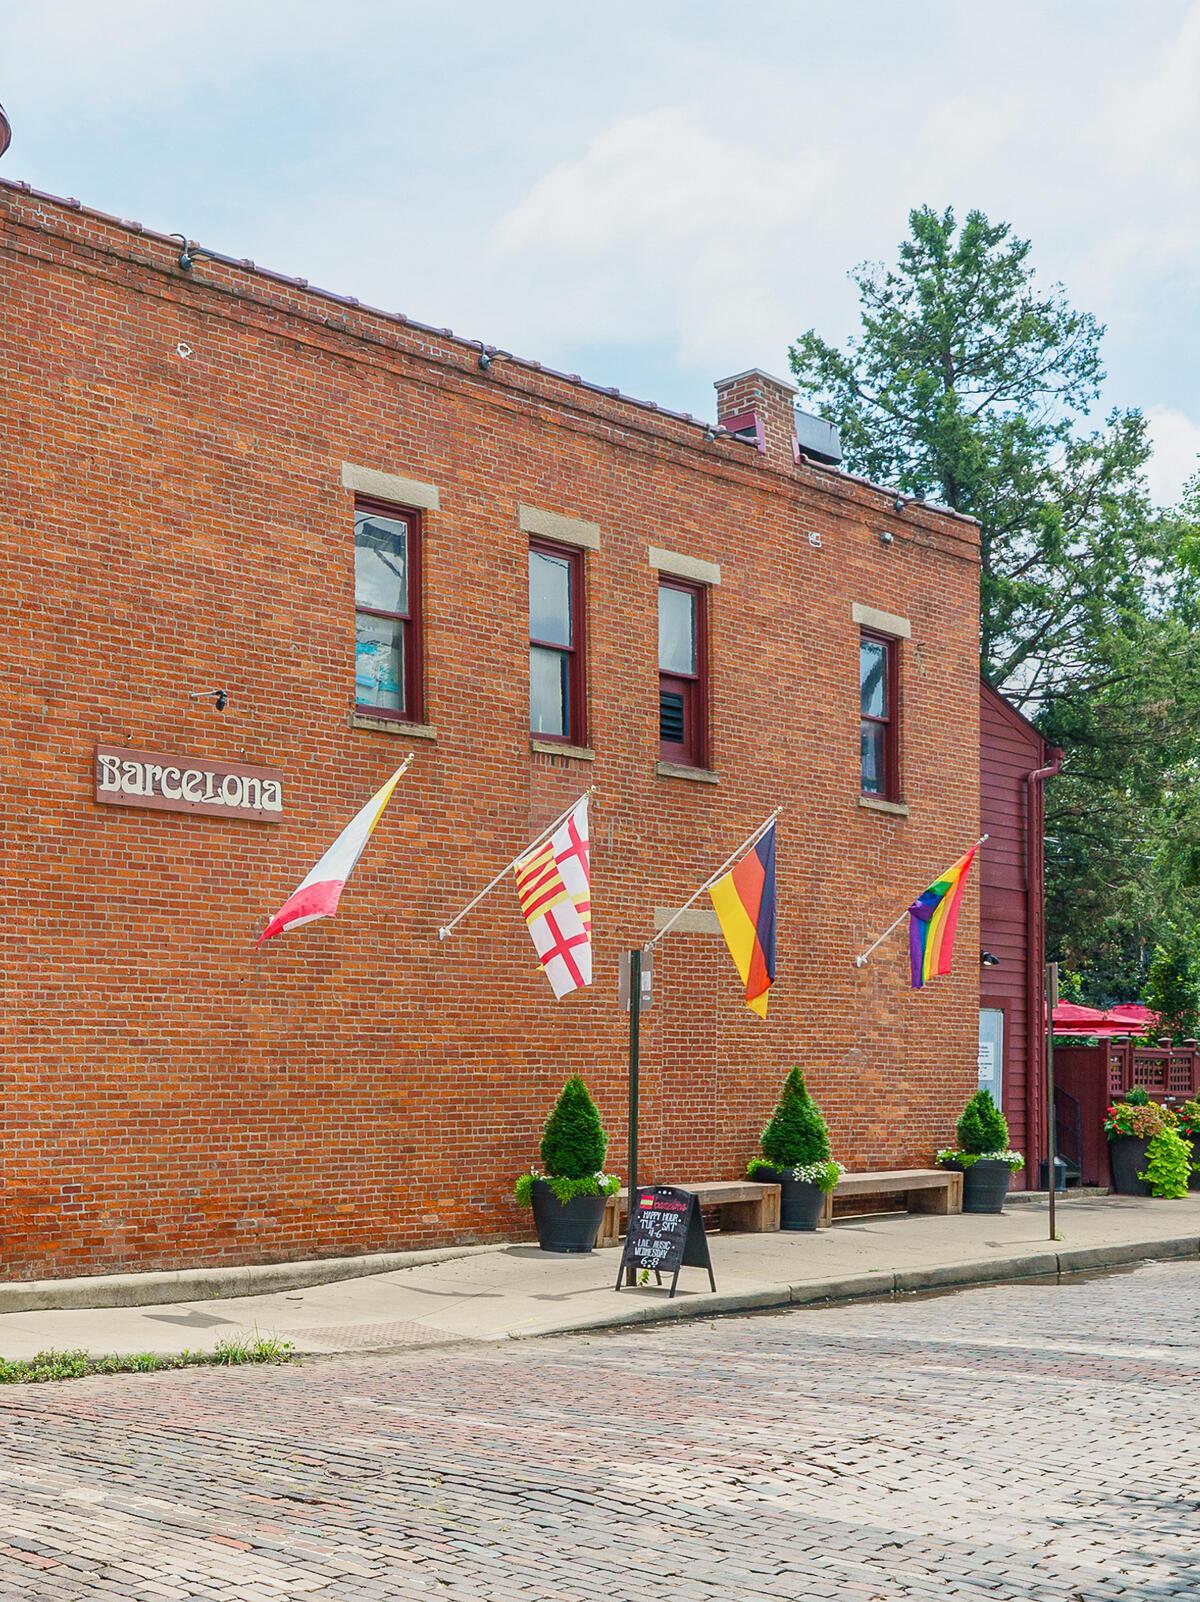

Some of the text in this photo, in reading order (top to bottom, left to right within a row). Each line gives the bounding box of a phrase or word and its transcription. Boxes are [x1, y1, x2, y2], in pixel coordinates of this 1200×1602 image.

[643, 1211, 678, 1222] HAPPY HOUR
[640, 1220, 655, 1229] TUE
[662, 1222, 677, 1232] SAT
[635, 1247, 667, 1258] WEDNESDAY
[641, 1257, 659, 1265] 6-8
